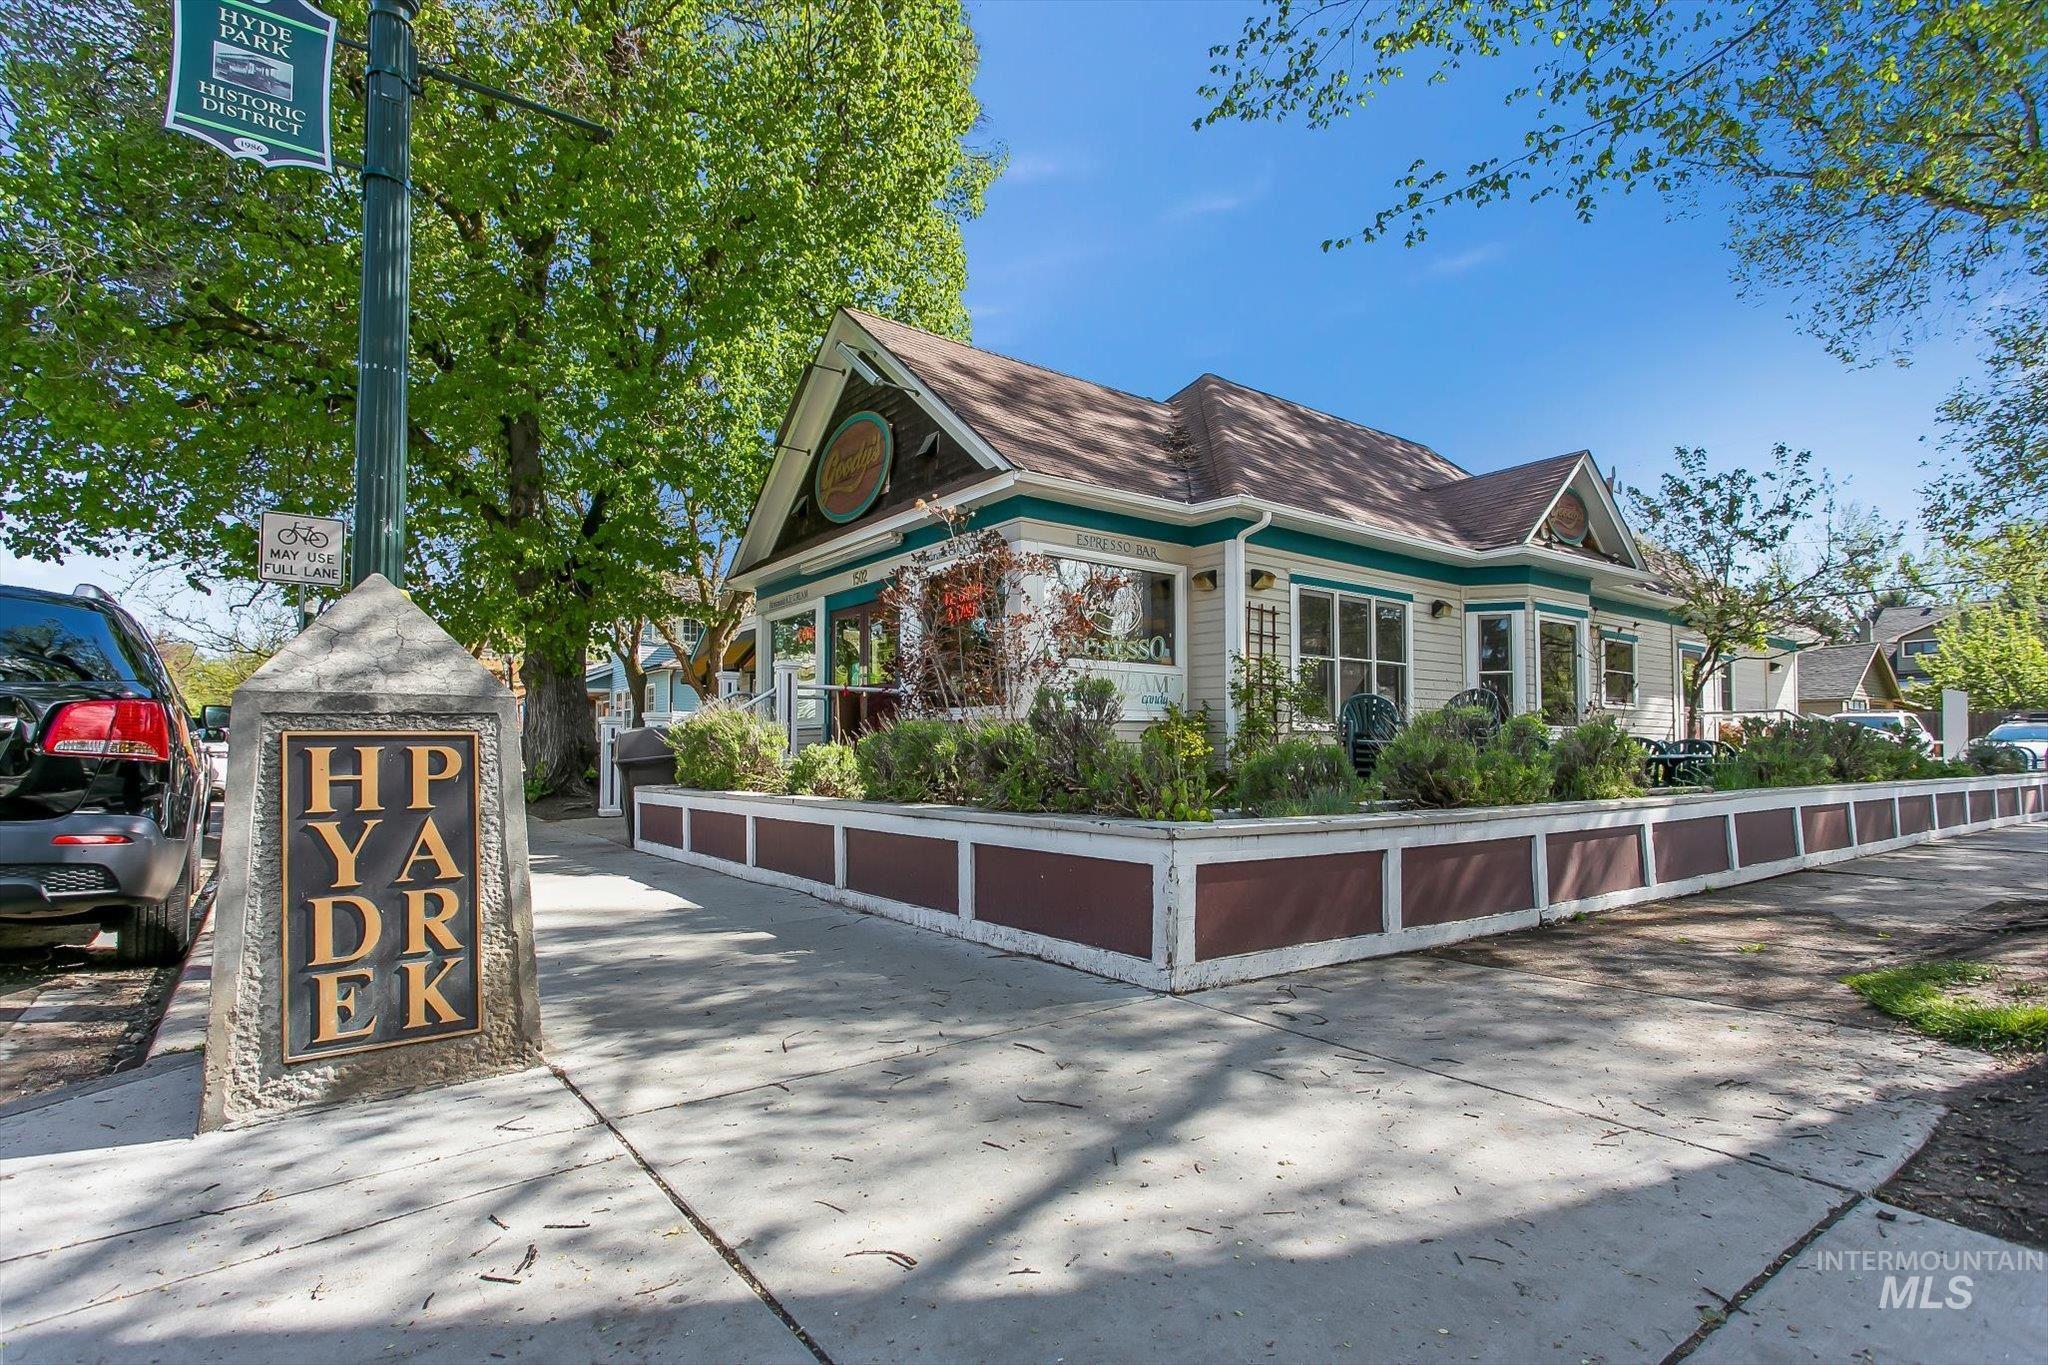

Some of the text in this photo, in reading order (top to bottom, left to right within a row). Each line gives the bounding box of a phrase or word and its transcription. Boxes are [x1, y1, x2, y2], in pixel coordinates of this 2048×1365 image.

[219, 6, 293, 43] HYDE
[219, 23, 291, 60] PARK
[198, 79, 306, 123] HISTORIC
[201, 96, 303, 137] DISTRICT
[240, 140, 263, 152] 1986
[270, 548, 335, 565] MAY USE
[1076, 533, 1161, 561] ESPRESSO BAR
[264, 562, 340, 580] FULL LANE
[852, 568, 868, 586] 1502
[1141, 691, 1168, 708] candy
[304, 746, 386, 1043] HYDE
[395, 745, 466, 1029] PARK
